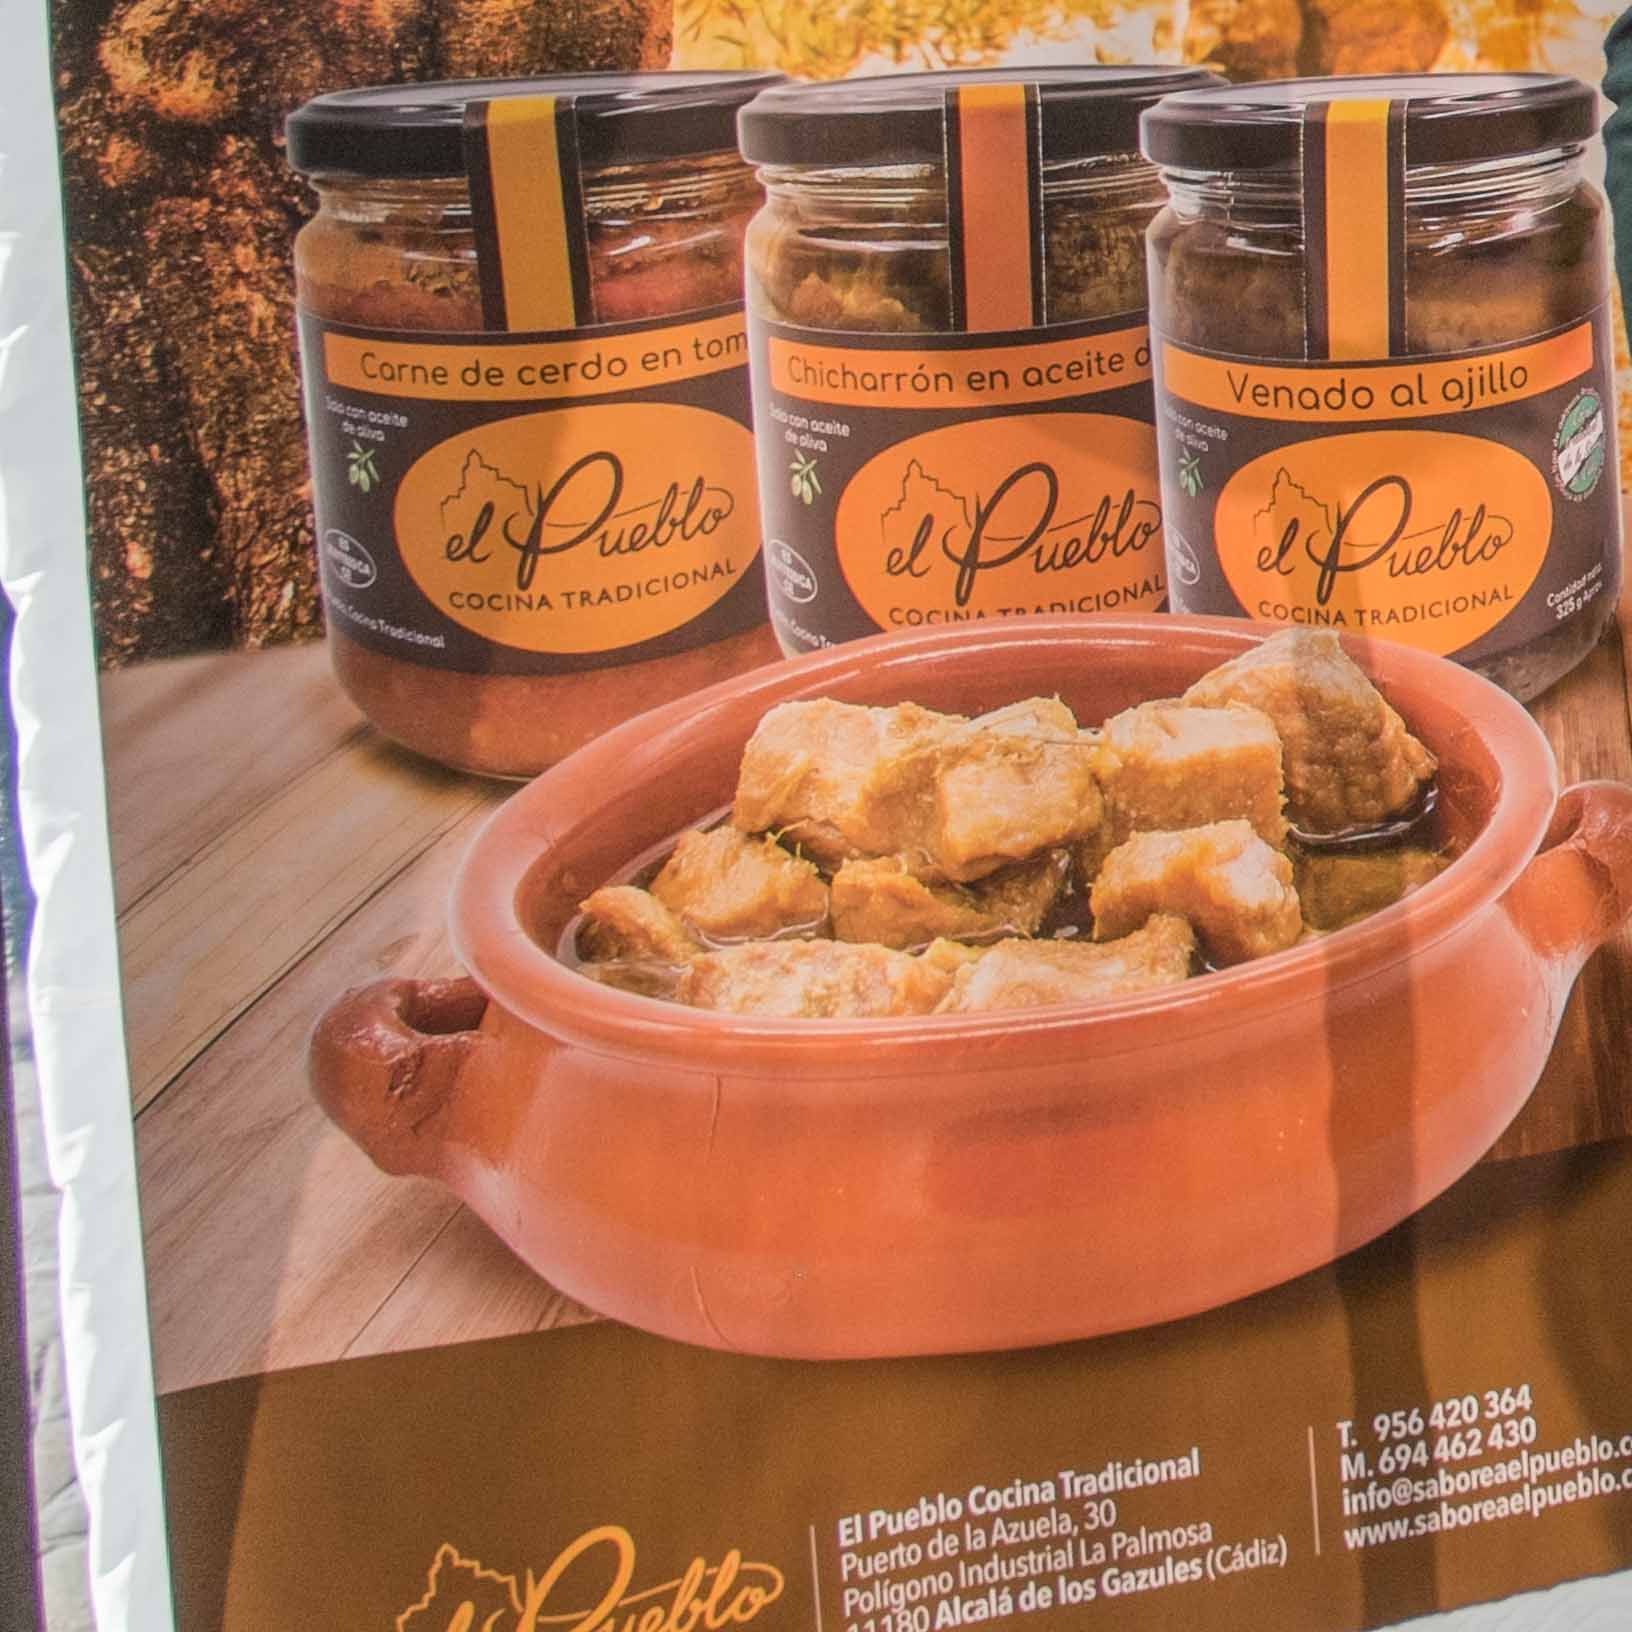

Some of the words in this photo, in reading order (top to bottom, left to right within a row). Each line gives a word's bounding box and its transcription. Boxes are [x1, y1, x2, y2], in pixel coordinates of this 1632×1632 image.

[360, 352, 449, 387] Carne
[460, 358, 505, 387] de
[517, 353, 628, 387] cerdo
[641, 345, 682, 372] en
[787, 355, 954, 394] Chicharrón
[967, 367, 1009, 394] en
[1023, 349, 1124, 388] aceite
[1227, 370, 1373, 411] Venado
[1391, 373, 1427, 406] al
[1441, 361, 1529, 410] ajillo
[445, 500, 496, 563] el
[503, 450, 735, 591] Pueblo
[886, 513, 934, 578] el
[942, 461, 1162, 607] Pueblo
[1257, 520, 1299, 575] el
[1306, 474, 1513, 606] Pueblo
[449, 591, 553, 613] COCINA
[561, 563, 737, 609] TRADICIONAL
[1258, 600, 1345, 626] COCINA
[1354, 590, 1514, 627] TRADICIONAL
[1335, 1420, 1358, 1448] T.
[1374, 1408, 1424, 1442] 956
[1429, 1395, 1478, 1431] 420
[1484, 1384, 1533, 1420] 364
[1340, 1453, 1374, 1483] M.
[1379, 1440, 1429, 1475] 694
[1434, 1429, 1483, 1463] 462
[1487, 1416, 1537, 1451] 430
[837, 1516, 862, 1547] El
[869, 1493, 963, 1541] Pueblo
[968, 1478, 1056, 1520] Cocina
[1059, 1447, 1200, 1499] Tradicional
[840, 1546, 924, 1582] Puerto
[927, 1529, 960, 1559] de
[964, 1522, 987, 1551] la
[990, 1506, 1079, 1545] Azuela,
[1083, 1499, 1117, 1531] 30
[843, 1573, 954, 1618] Polígono
[959, 1544, 1074, 1588] Industrial
[1080, 1538, 1106, 1567] La
[1111, 1522, 1213, 1562] Palmosa
[934, 1587, 1014, 1631] Alcalá
[1019, 1578, 1053, 1610] de
[1059, 1573, 1097, 1603] los
[1101, 1556, 1202, 1598] Gazules
[1206, 1535, 1288, 1582] (Cádiz)
